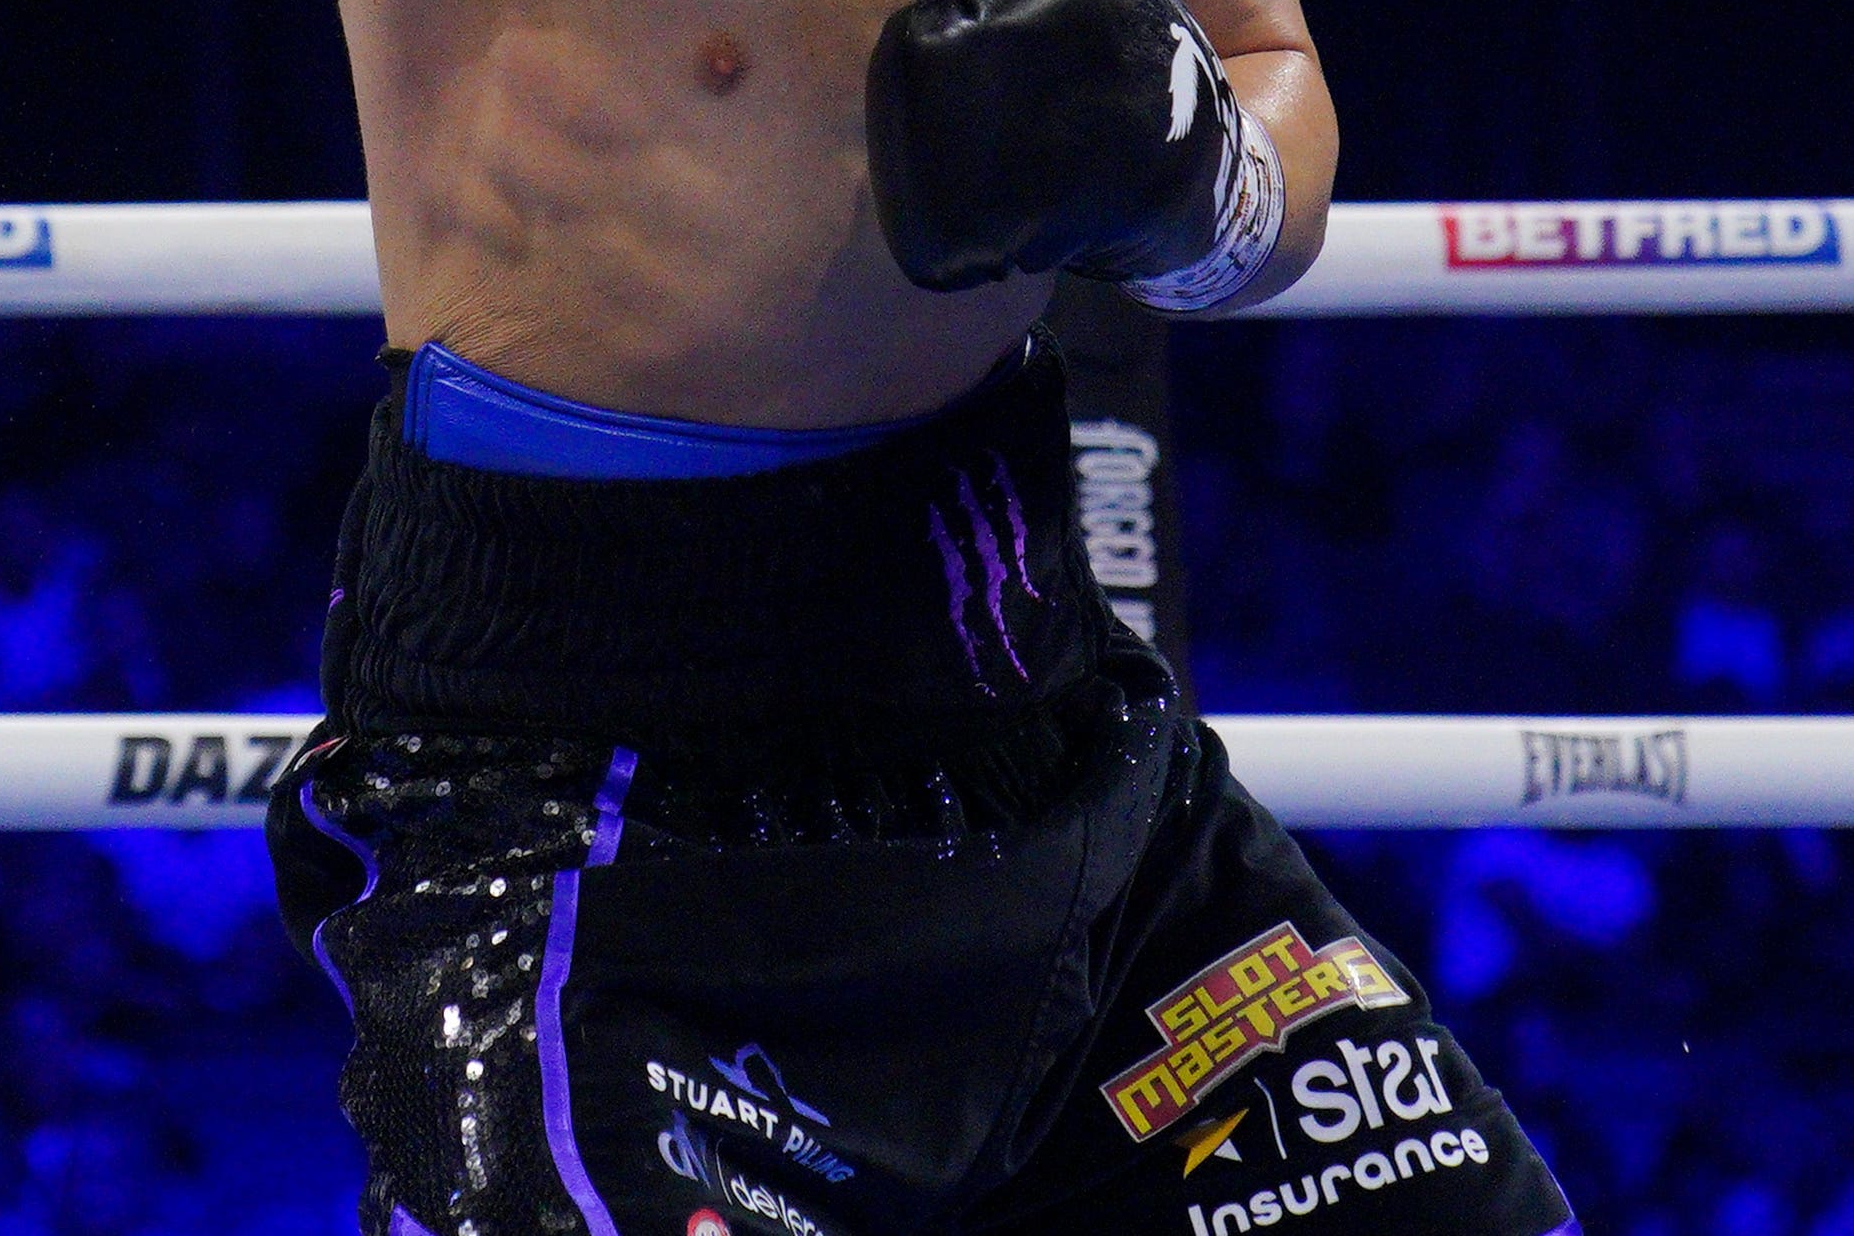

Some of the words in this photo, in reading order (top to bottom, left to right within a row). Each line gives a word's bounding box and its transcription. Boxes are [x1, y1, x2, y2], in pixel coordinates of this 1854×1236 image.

[1452, 203, 1832, 263] BETFRED
[106, 735, 294, 805] DAZ
[1160, 933, 1302, 1042] SLOT
[646, 1061, 780, 1150] STUART
[782, 1124, 856, 1183] PILING
[1187, 1128, 1490, 1236] Insurance
